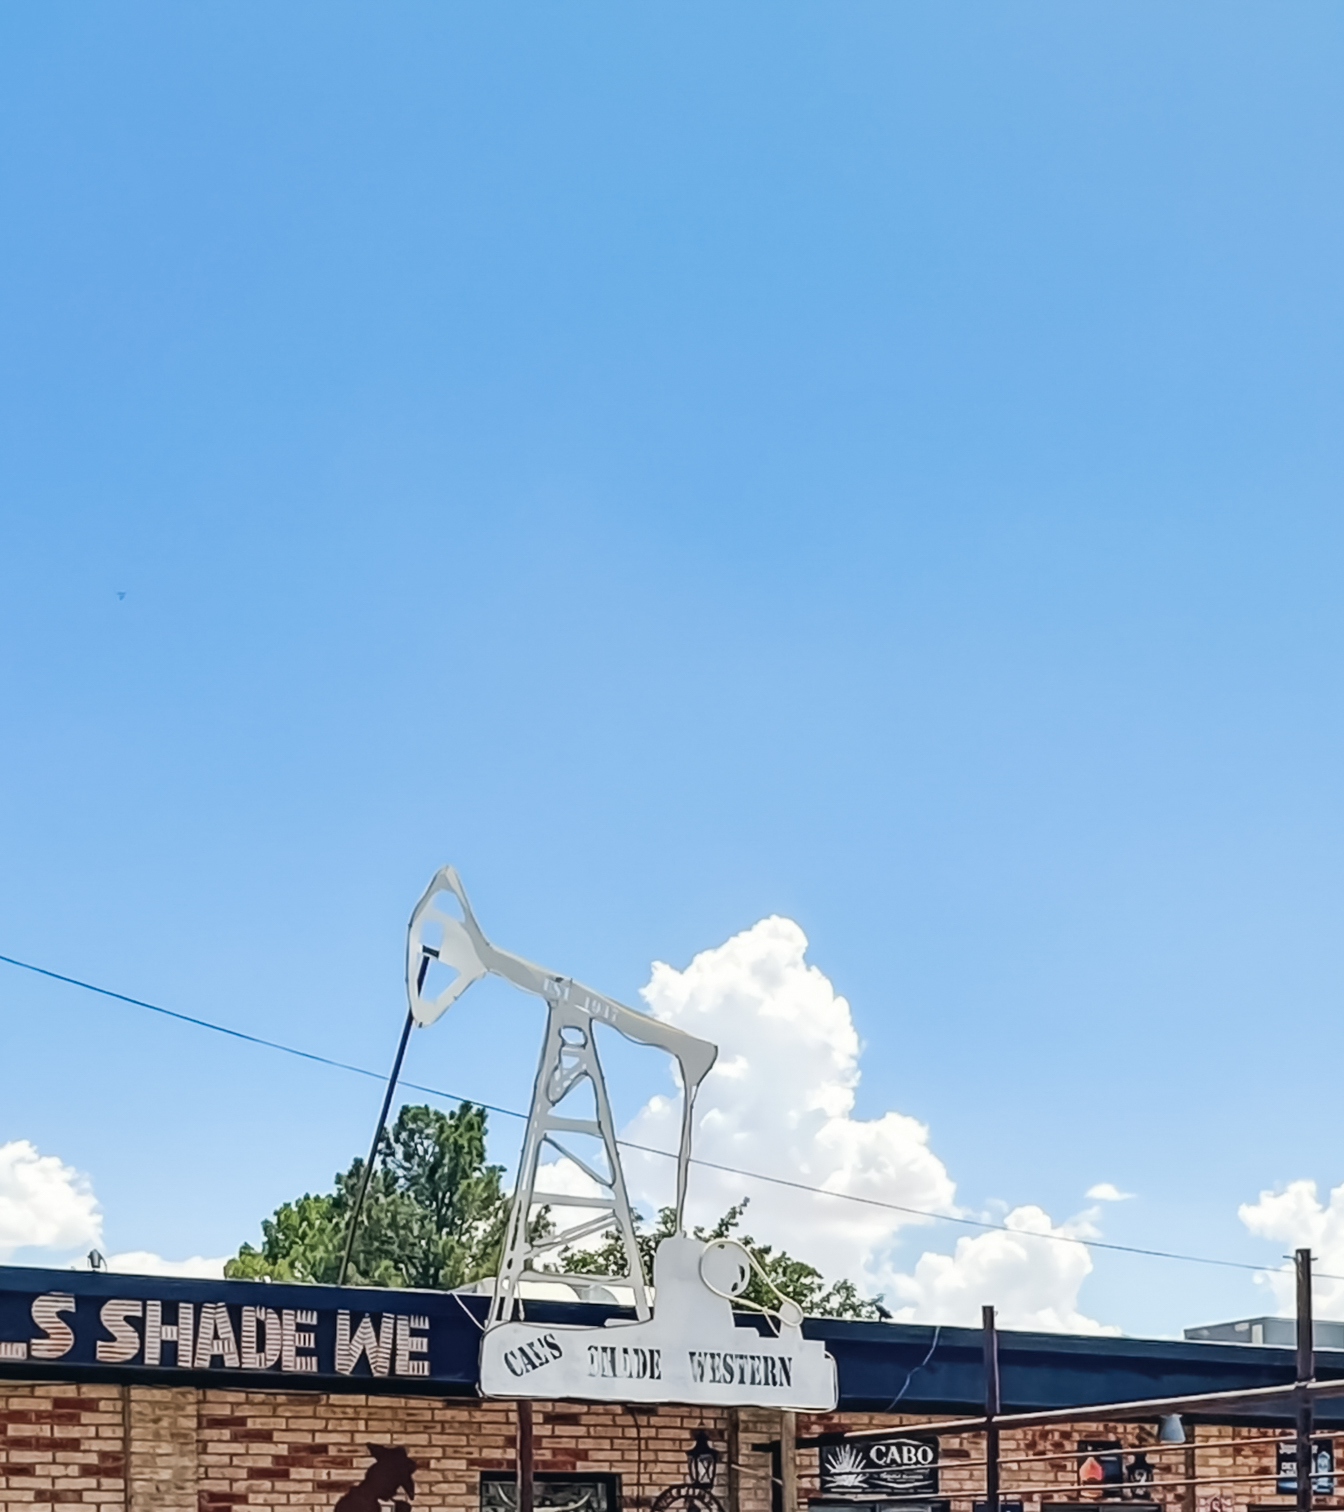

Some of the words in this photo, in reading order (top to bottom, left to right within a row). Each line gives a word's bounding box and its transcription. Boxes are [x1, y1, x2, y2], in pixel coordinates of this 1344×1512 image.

[96, 1299, 319, 1373] SHADE
[334, 1308, 431, 1378] WE
[504, 1333, 563, 1377] CAL'S
[689, 1350, 794, 1388] WESTERN
[869, 1445, 934, 1465] CABO
